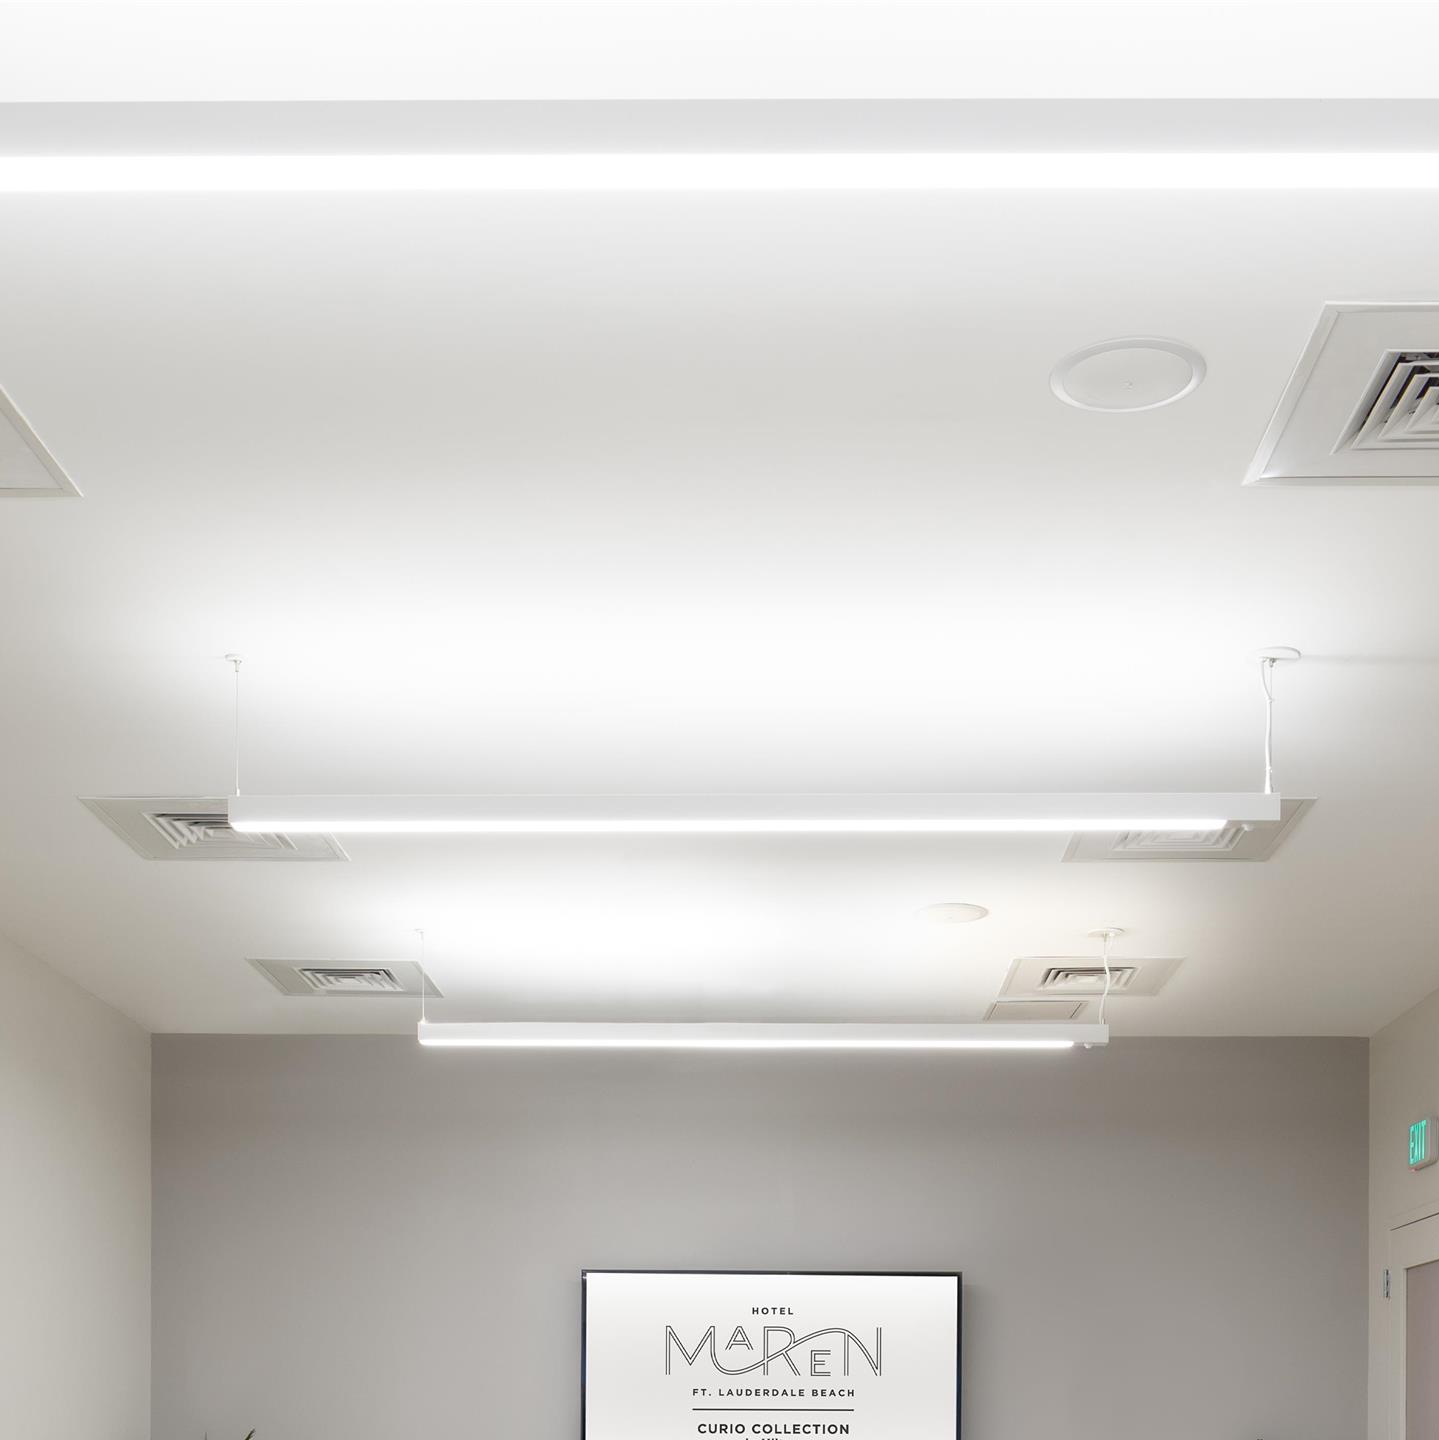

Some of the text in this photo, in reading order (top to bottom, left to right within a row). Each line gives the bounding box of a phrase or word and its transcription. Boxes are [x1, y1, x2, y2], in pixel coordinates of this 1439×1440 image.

[1409, 1119, 1426, 1165] EXIT
[752, 1307, 794, 1315] HOTEL
[665, 1325, 882, 1377] MAREN
[692, 1388, 855, 1398] FT. LAUDERDALE BEACH
[697, 1423, 850, 1435] CURIO COLLECTION
